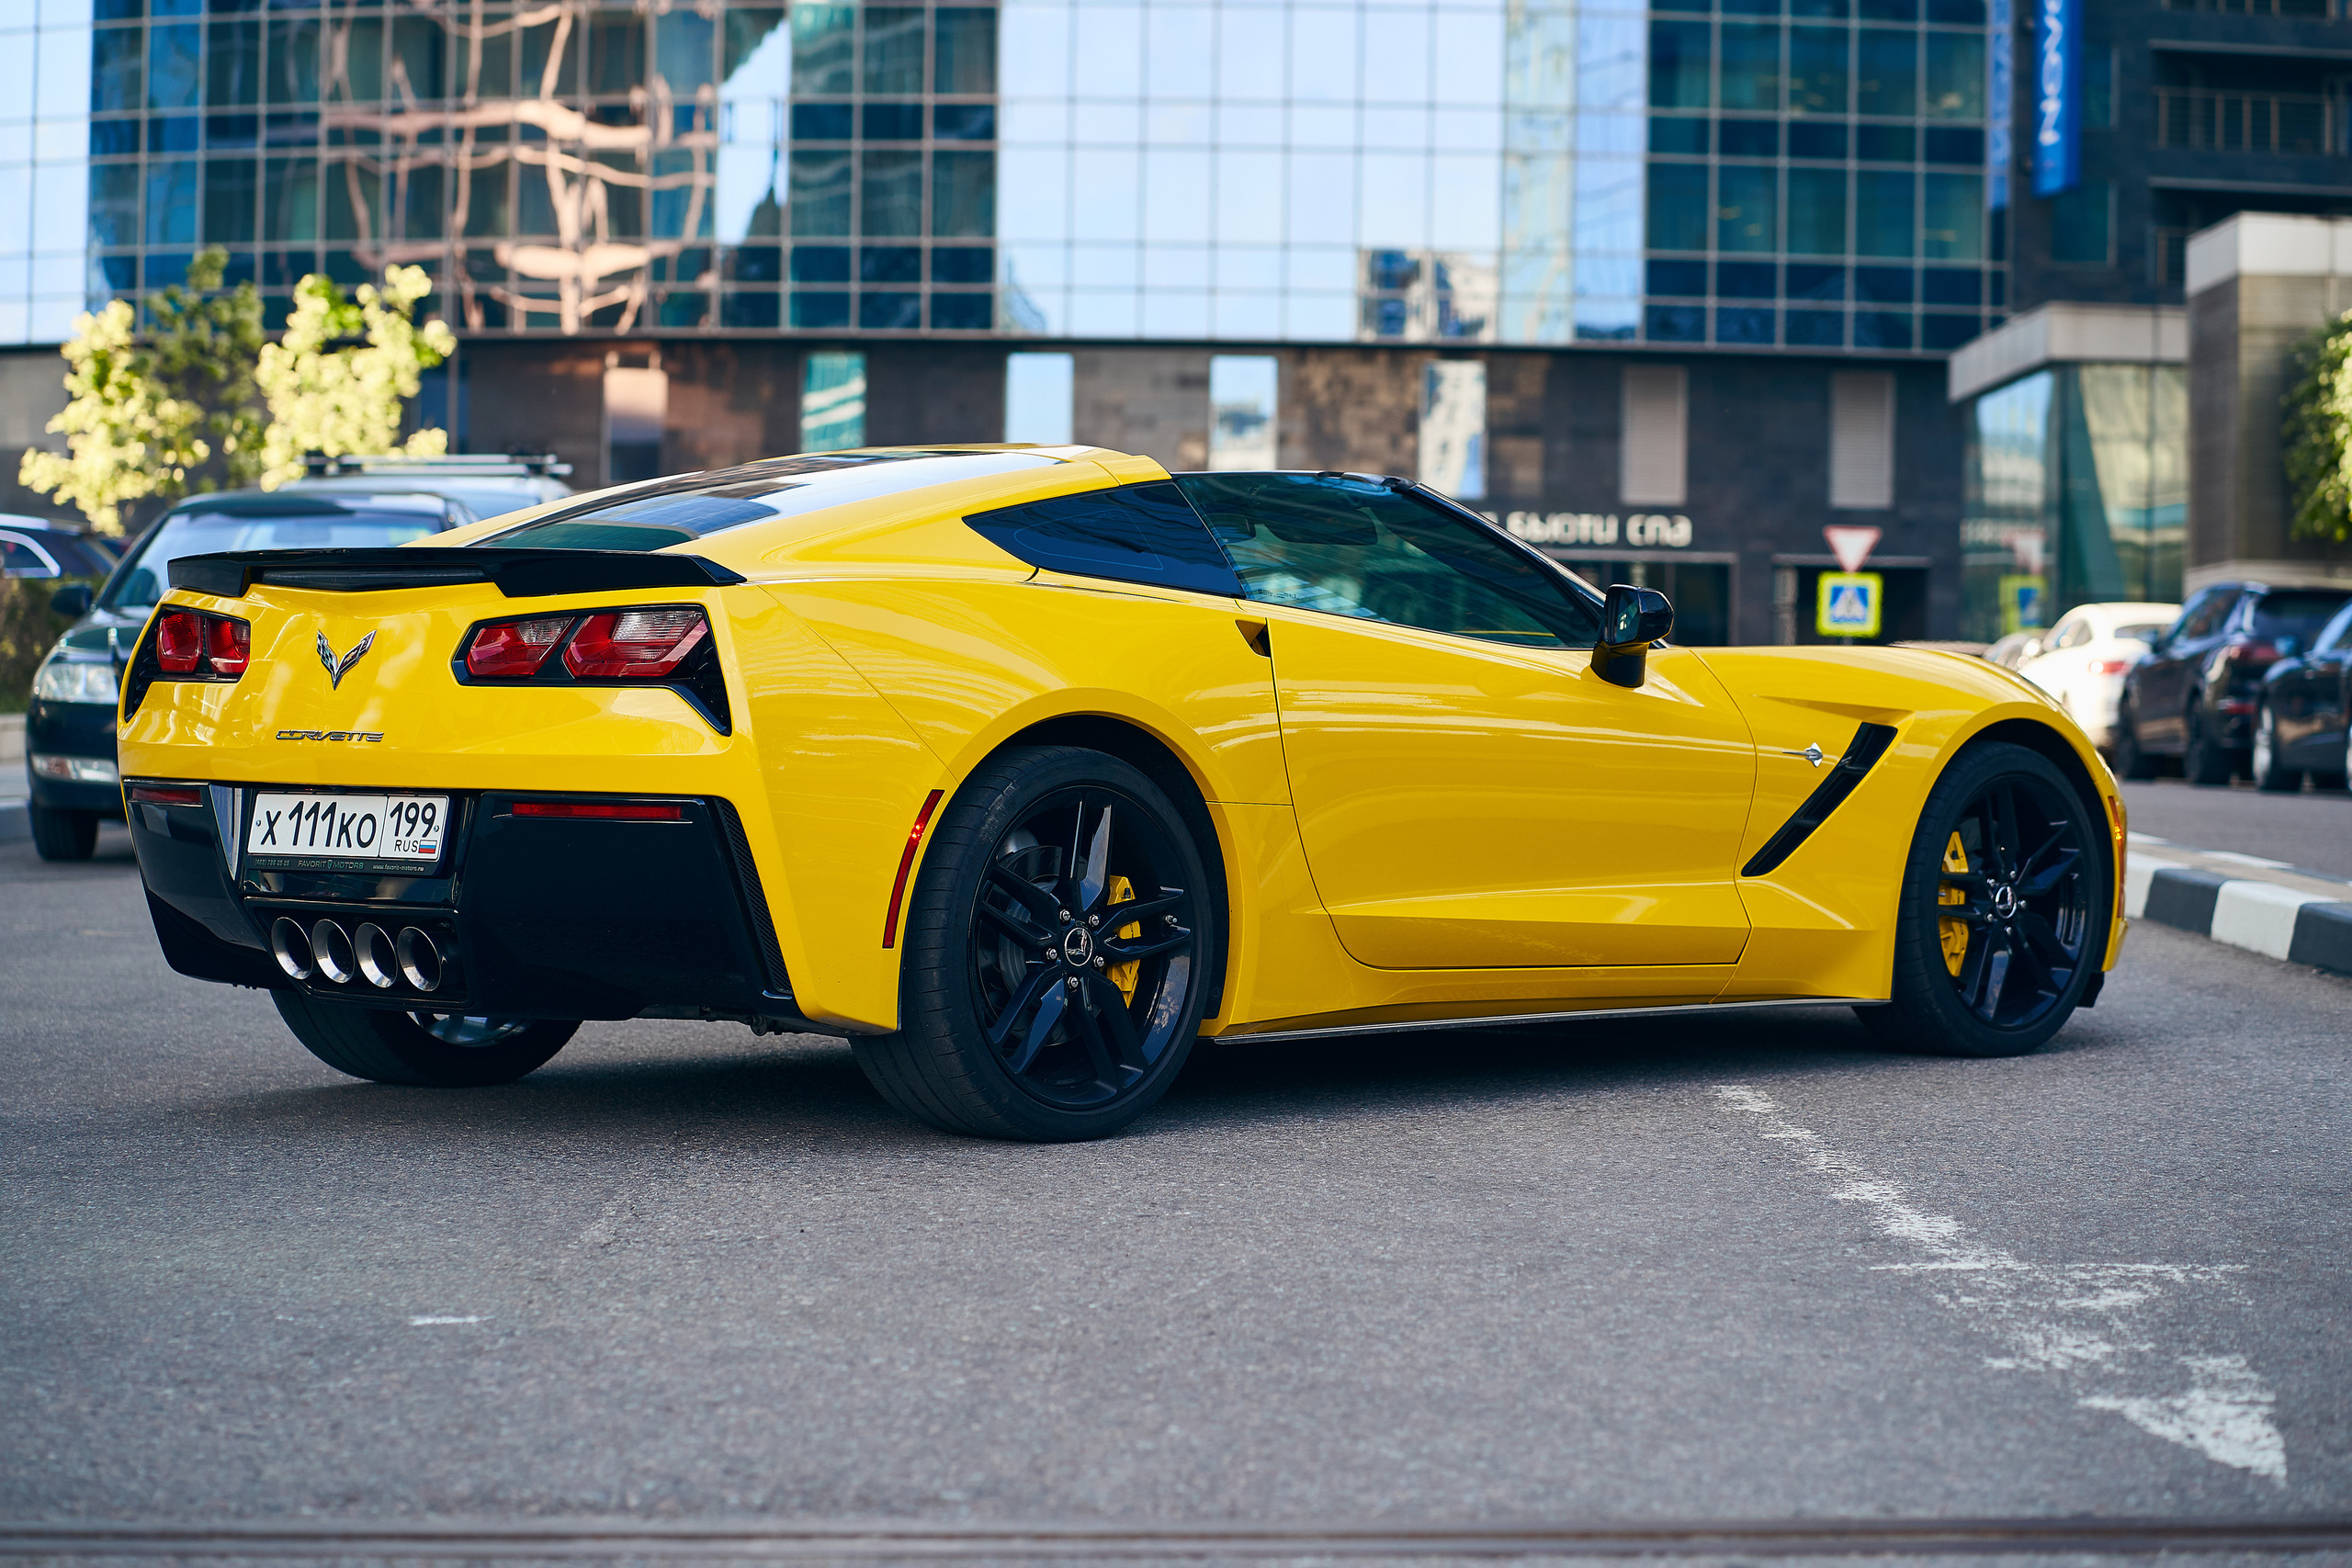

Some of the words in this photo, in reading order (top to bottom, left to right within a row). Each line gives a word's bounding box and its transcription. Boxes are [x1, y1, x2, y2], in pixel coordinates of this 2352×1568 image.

[276, 729, 384, 742] CORVETTE
[390, 802, 437, 838] 199
[394, 840, 418, 852] RUS
[298, 860, 327, 868] FAVORIT
[332, 861, 364, 870] MOTORS
